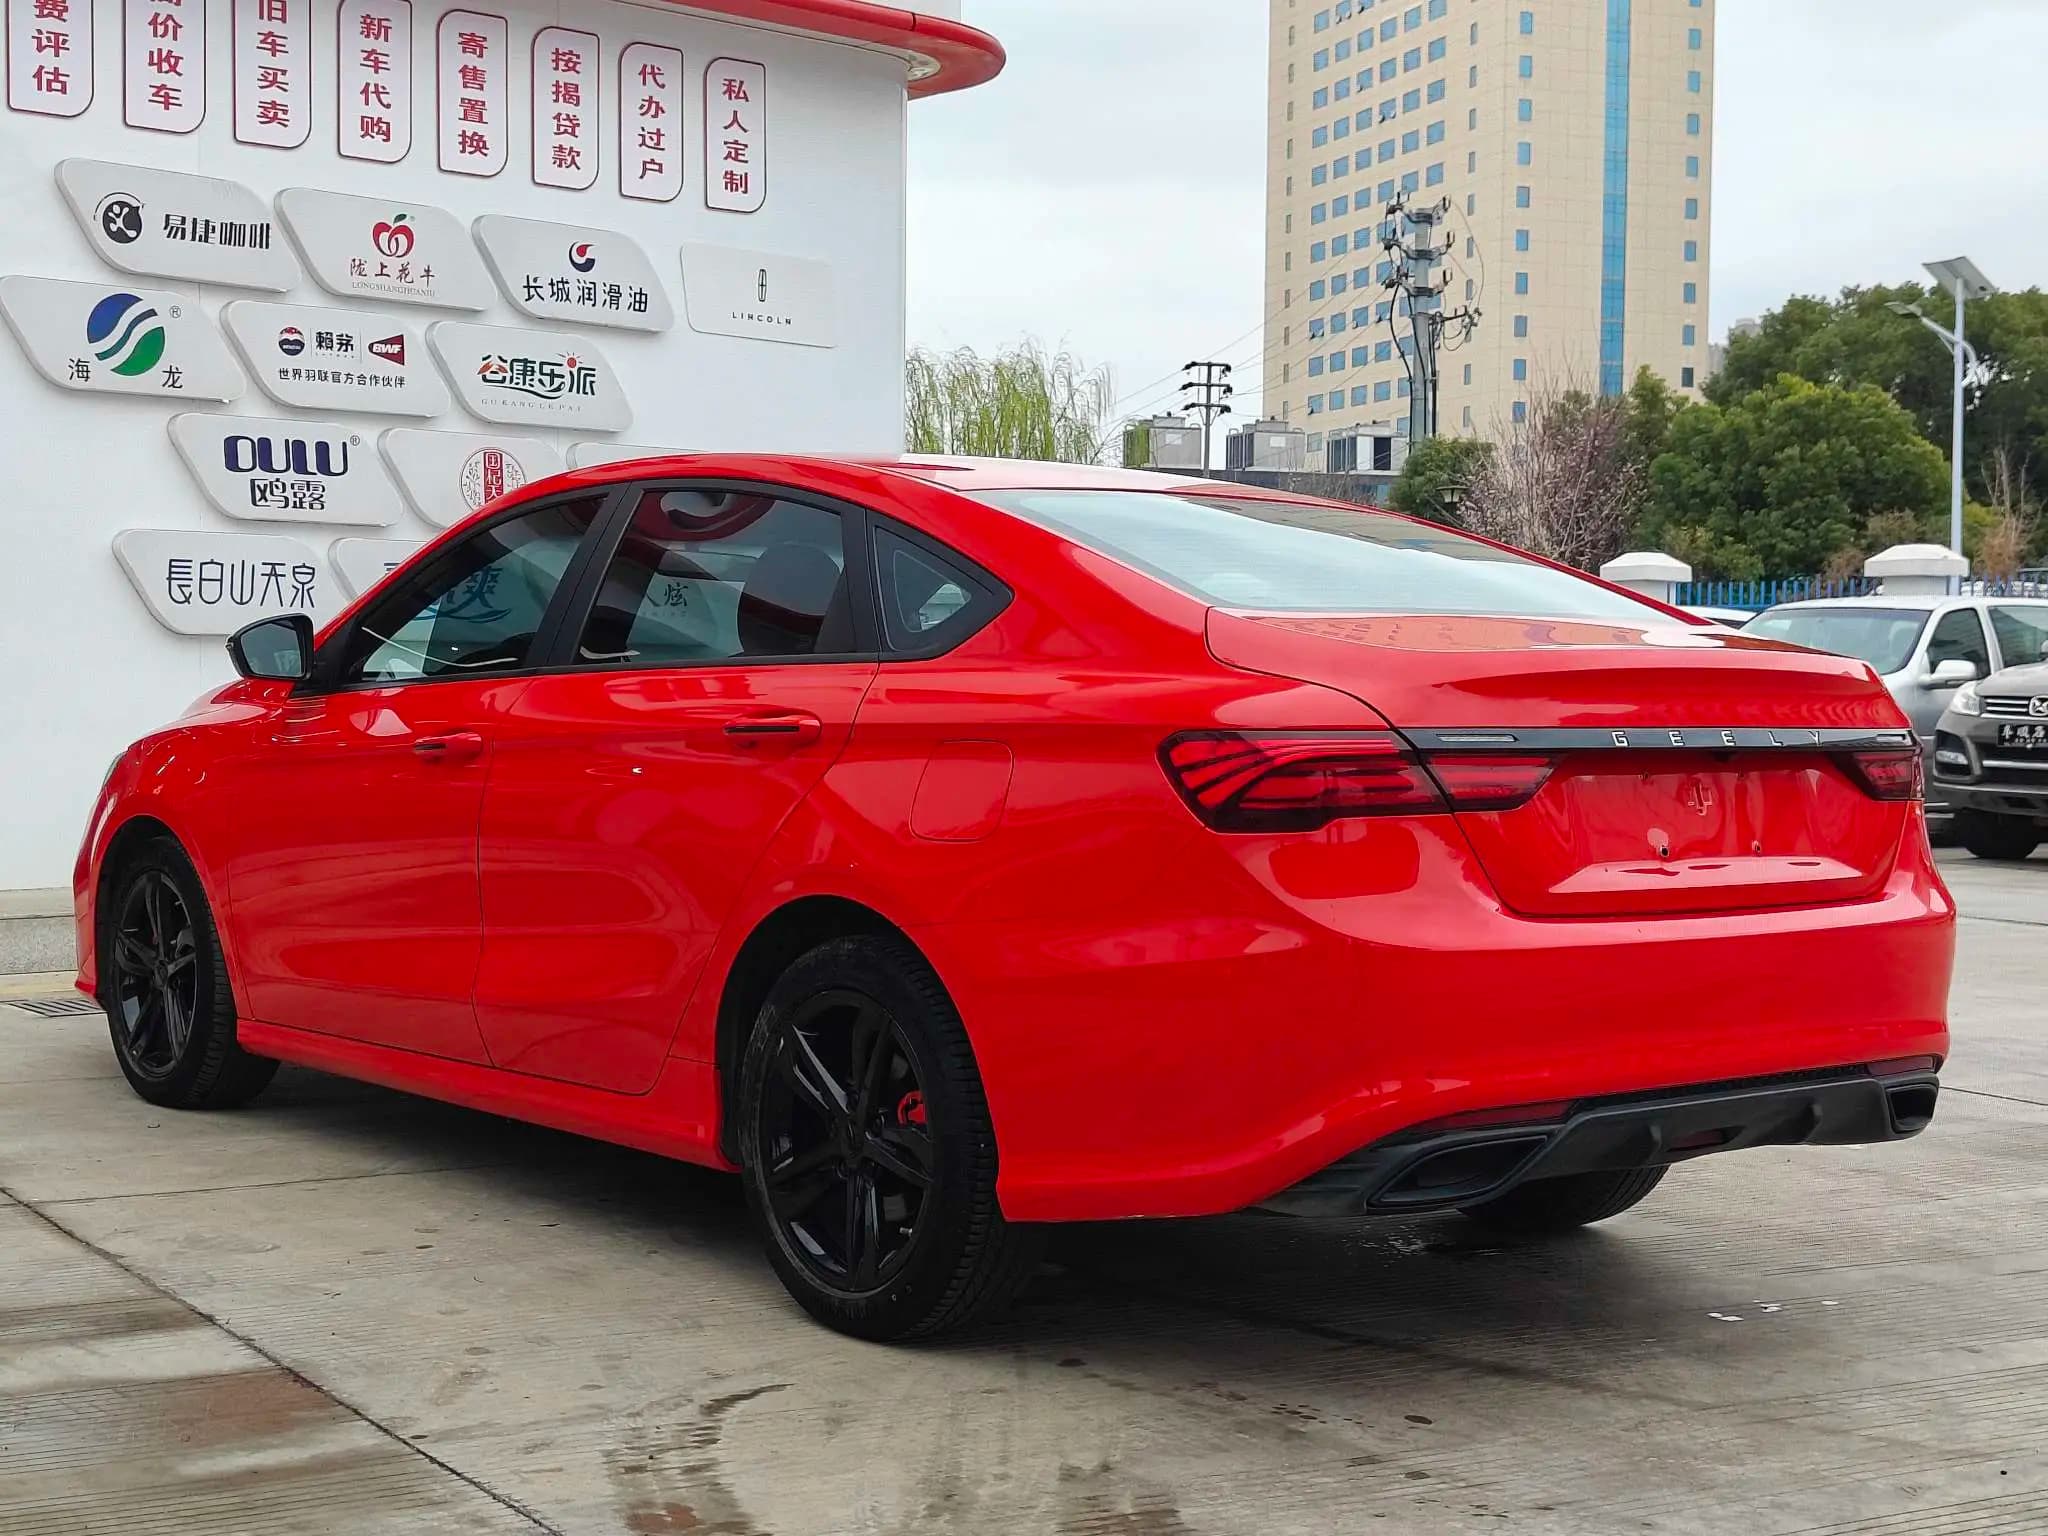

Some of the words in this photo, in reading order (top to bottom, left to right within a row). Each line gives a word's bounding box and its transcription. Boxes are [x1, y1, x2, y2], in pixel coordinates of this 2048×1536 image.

[32, 0, 70, 95] 费评估
[147, 0, 184, 111] 价收车
[257, 0, 290, 128] 旧车买卖
[359, 14, 393, 143] 新车代购
[457, 31, 489, 158] 寄售置换
[551, 47, 582, 170] 按揭贷款
[638, 63, 666, 180] 代办过户
[721, 77, 750, 195] 私人定制
[163, 212, 271, 250] 易捷咖啡
[350, 258, 435, 288] 陇上花牛
[522, 274, 649, 313] 长城润滑油
[732, 311, 792, 325] LINCOLN
[372, 343, 403, 354] BWF
[278, 367, 405, 388] 世界羽联官方合作伙伴
[477, 353, 597, 396] 谷康乐派
[223, 435, 349, 477] OULU
[250, 478, 326, 510] 鸥露
[1611, 730, 1823, 747] GEELY
